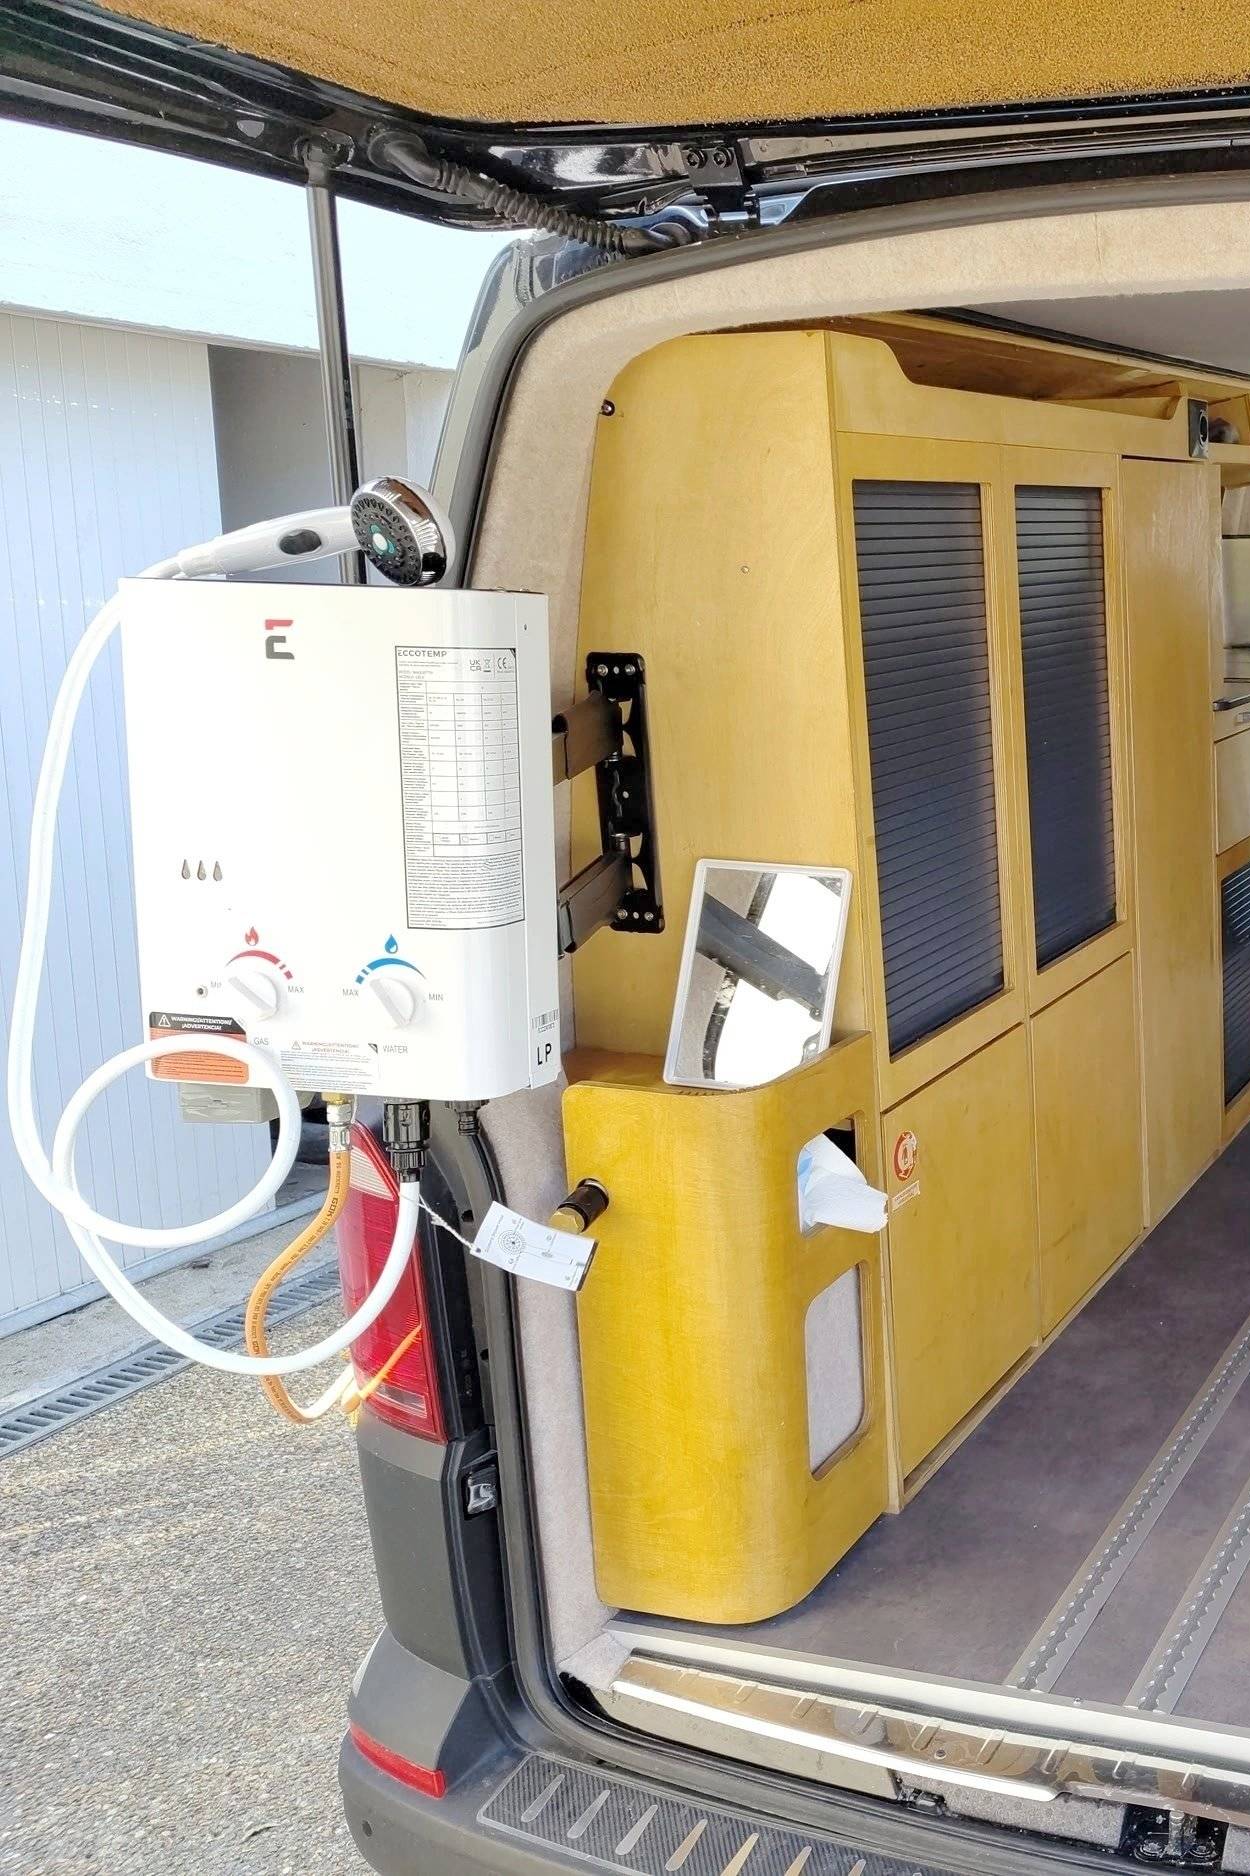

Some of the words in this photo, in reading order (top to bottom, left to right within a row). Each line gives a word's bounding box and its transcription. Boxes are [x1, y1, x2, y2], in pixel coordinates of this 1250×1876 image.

[397, 650, 447, 658] ECCOTEMP
[287, 985, 304, 994] MAX
[342, 988, 359, 997] MAX
[428, 993, 444, 1001] MIN
[253, 1036, 269, 1046] GAS
[382, 1045, 409, 1054] WATER
